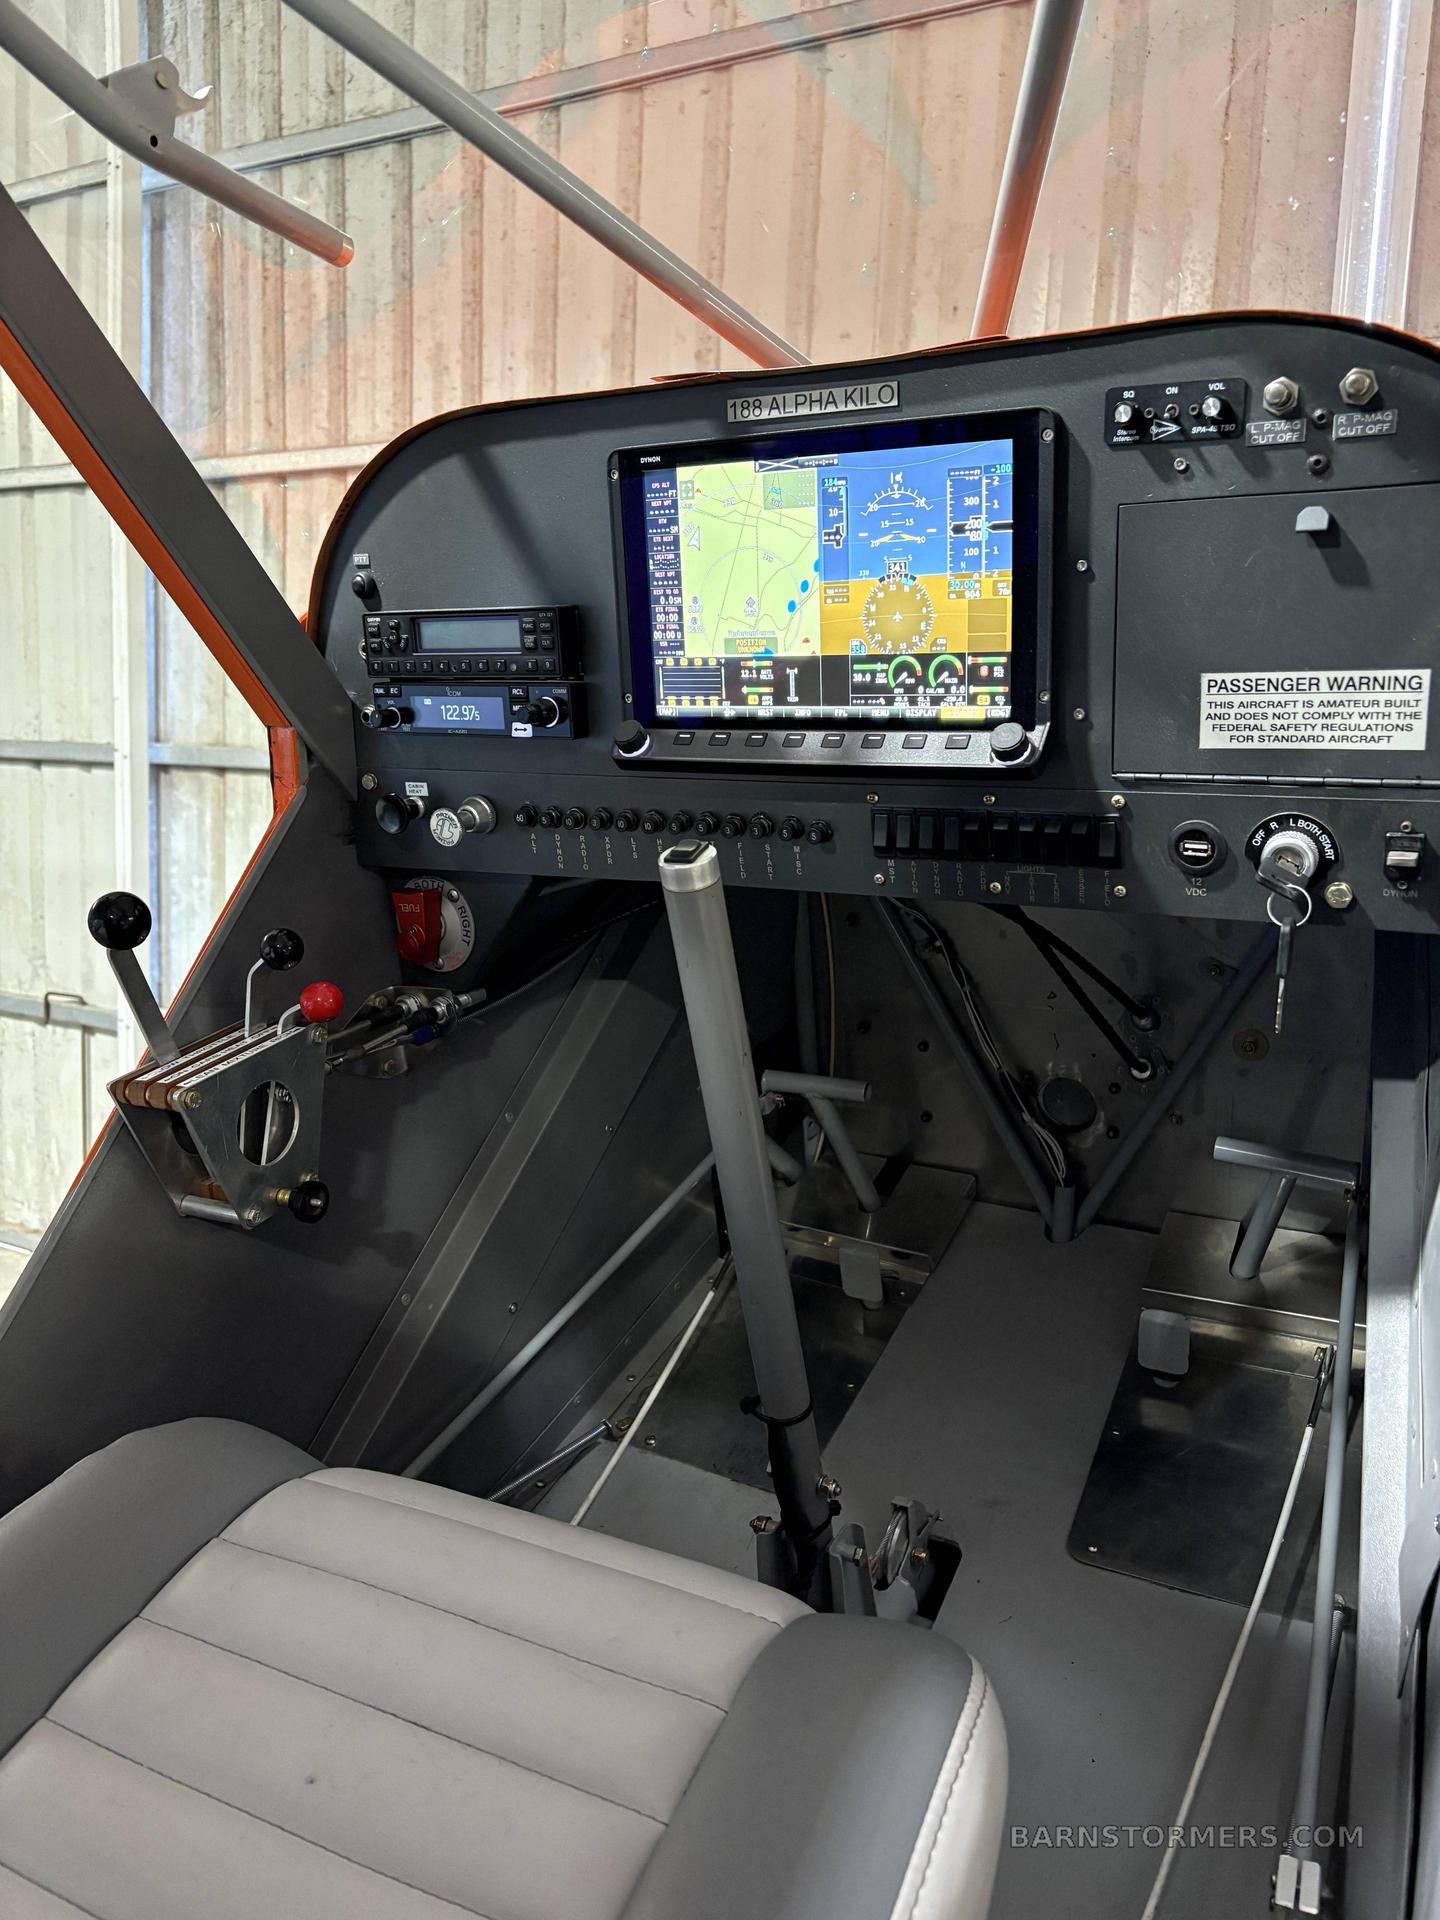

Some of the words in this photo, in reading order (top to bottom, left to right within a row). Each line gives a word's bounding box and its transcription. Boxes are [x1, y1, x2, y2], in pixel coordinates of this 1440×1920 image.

[1165, 386, 1179, 395] ON
[1208, 382, 1226, 391] VOL
[1122, 390, 1136, 399] SQ
[729, 398, 763, 420] 188
[767, 390, 839, 416] ALPHA
[844, 384, 895, 409] KILO
[1337, 416, 1347, 426] R
[1352, 411, 1393, 424] P-MAG
[1220, 423, 1236, 432] TSO
[1250, 423, 1258, 433] L
[1263, 420, 1301, 433] P-MAG
[1338, 424, 1363, 436] CUT
[1365, 422, 1391, 434] OFF
[1251, 433, 1275, 444] CUT
[1277, 431, 1300, 443] OFF
[640, 456, 661, 464] DYNON
[963, 496, 980, 506] 300
[828, 507, 839, 518] 10
[880, 519, 890, 529] 15
[905, 518, 914, 526] 15
[963, 547, 980, 556] 100
[888, 562, 907, 573] 341
[656, 613, 679, 622] 00:00
[653, 630, 675, 639] 00:00
[735, 638, 767, 646] POSITION
[740, 669, 757, 678] 12.1
[852, 673, 871, 683] 30.0
[950, 685, 965, 694] 0.0
[1206, 677, 1321, 694] PASSENGER
[1326, 675, 1423, 692] WARNING
[917, 686, 925, 694] 0
[1208, 700, 1235, 710] THIS
[1237, 700, 1299, 710] AIRCRAFT
[1302, 699, 1314, 709] IS
[1317, 699, 1381, 709] AMATEUR
[1384, 699, 1423, 708] BUILT
[440, 704, 481, 721] 122.975
[757, 708, 774, 716] NRST
[794, 708, 812, 717] INFO
[834, 708, 848, 717] FPL
[871, 708, 890, 717] MENU
[905, 708, 937, 717] DISPLAY
[1205, 712, 1231, 721] AND
[1234, 712, 1269, 721] DOES
[1272, 712, 1299, 721] NOT
[1302, 711, 1355, 721] COMPLY
[1358, 711, 1391, 720] WITH
[1395, 711, 1423, 720] THE
[1212, 723, 1267, 732] FEDERAL
[1270, 723, 1318, 732] SAFETY
[1320, 723, 1414, 732] REGULATIONS
[1229, 735, 1255, 744] FOR
[1257, 735, 1325, 744] STANDARD
[1328, 735, 1395, 744] AIRCRAFT
[515, 814, 524, 822] 60
[542, 817, 547, 825] 5
[566, 818, 572, 826] 10
[1289, 818, 1296, 827] L
[617, 820, 625, 828] 10
[644, 822, 652, 831] 10
[671, 822, 677, 831] 5
[1269, 821, 1279, 830] R
[1296, 819, 1321, 837] BOTH
[725, 826, 731, 834] 3
[783, 829, 788, 837] 5
[811, 832, 817, 840] 5
[1251, 830, 1266, 847] OFF
[554, 834, 564, 870] DYNON
[604, 836, 614, 865] XPDR
[630, 837, 639, 859] LTS
[1318, 834, 1336, 861] START
[579, 835, 589, 871] RADIO
[737, 842, 746, 879] FIELD
[764, 844, 773, 880] START
[793, 845, 803, 875] MISC
[887, 859, 896, 884] MST
[932, 861, 941, 896] DYNON
[956, 863, 964, 897] RADIO
[1191, 878, 1203, 886] 12
[414, 880, 444, 891] BOTH
[1185, 887, 1207, 897] VDC
[398, 903, 421, 913] FUEL
[457, 905, 472, 947] RIGHT
[221, 1043, 267, 1067] MIXTURE
